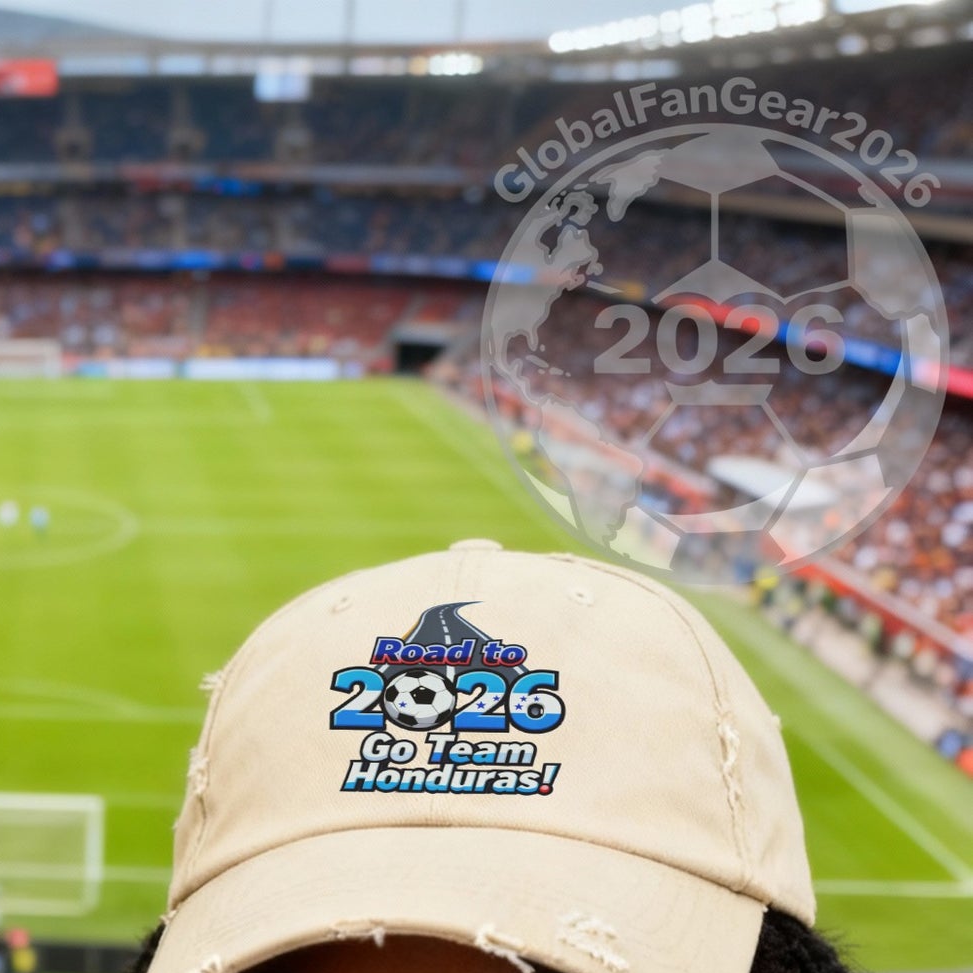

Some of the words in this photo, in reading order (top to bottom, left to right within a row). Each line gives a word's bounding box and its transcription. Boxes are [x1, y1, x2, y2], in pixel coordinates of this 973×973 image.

[370, 636, 476, 665] Road
[481, 639, 527, 667] to
[359, 731, 417, 764] Go
[425, 732, 537, 766] Team
[340, 759, 561, 796] Honduras!
